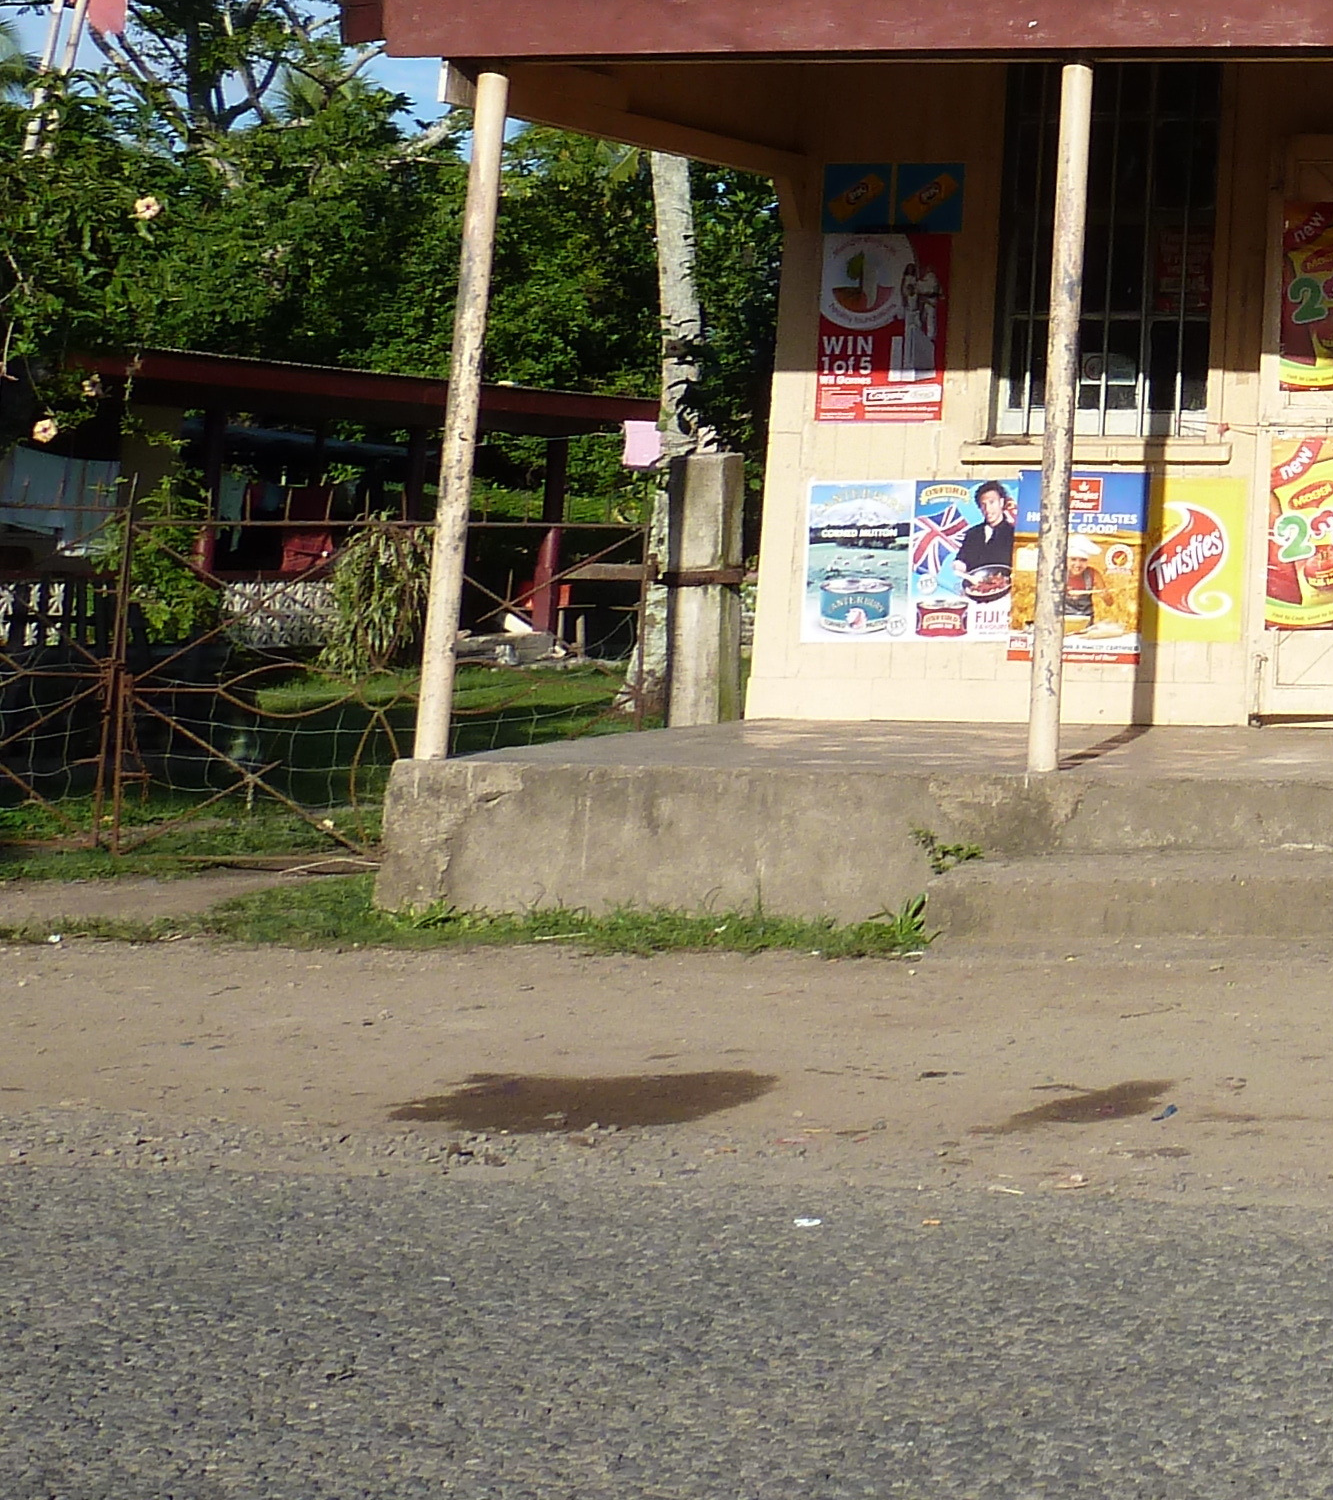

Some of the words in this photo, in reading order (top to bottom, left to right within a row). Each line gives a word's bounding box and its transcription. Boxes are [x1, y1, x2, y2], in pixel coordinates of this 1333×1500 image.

[1294, 211, 1325, 242] new
[822, 336, 873, 355] WIN
[1279, 446, 1313, 481] new
[925, 486, 968, 497] OXFORD
[1292, 483, 1333, 508] Maggi
[1083, 514, 1095, 523] IT
[1096, 514, 1138, 524] TASTES
[859, 528, 898, 537] MUTTON
[1077, 525, 1118, 534] GOOD!
[1149, 528, 1224, 591] Twisties
